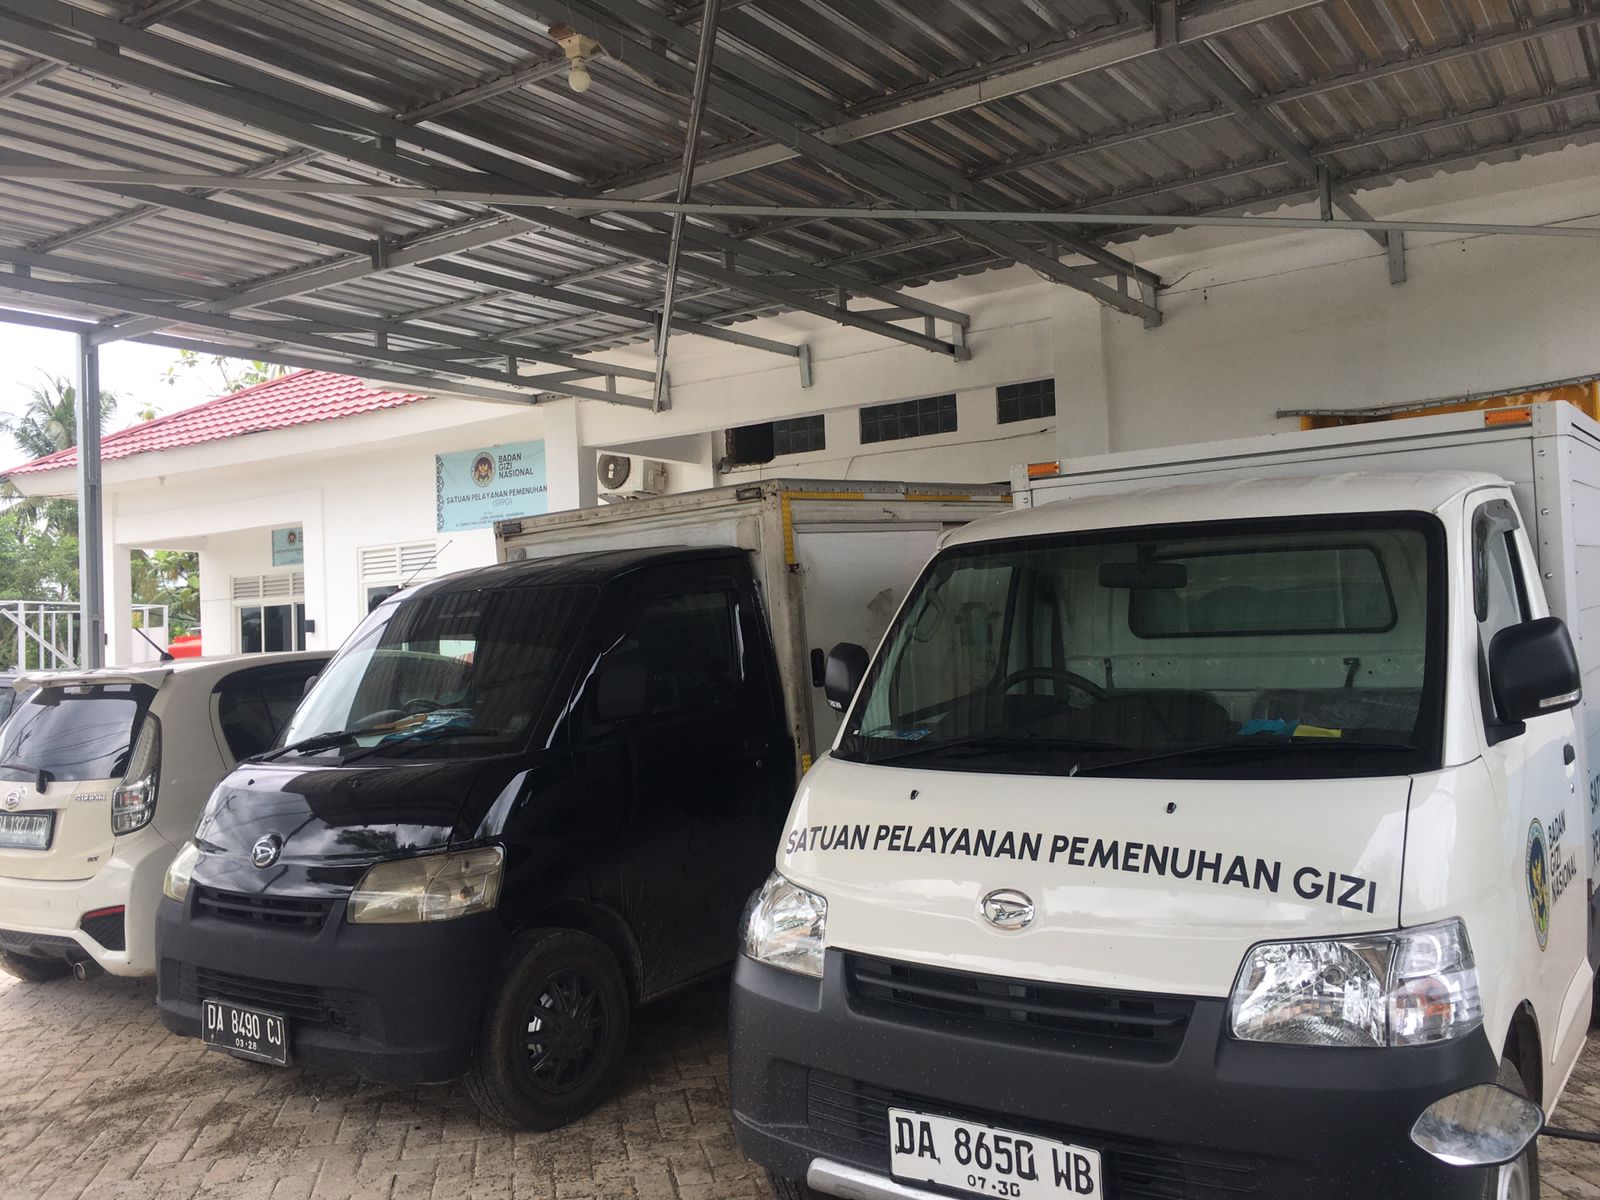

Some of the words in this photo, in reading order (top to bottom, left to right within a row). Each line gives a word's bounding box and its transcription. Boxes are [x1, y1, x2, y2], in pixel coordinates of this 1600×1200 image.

[498, 453, 522, 463] BADAN
[498, 462, 513, 471] GIZI
[498, 467, 534, 480] NASIONAL
[446, 496, 471, 505] SATUAN
[471, 489, 509, 502] PELAYANAN
[508, 485, 548, 497] PEMENUHAN
[1548, 808, 1566, 850] BADAN
[785, 824, 871, 855] SATUAN
[873, 824, 1043, 862] PELAYANAN
[1048, 834, 1282, 893] PEMENUHAN
[1292, 866, 1377, 914] GIZI
[1550, 843, 1562, 876] GIZI
[1551, 851, 1577, 904] NASIONAL
[207, 1004, 224, 1032] DA
[231, 1009, 261, 1040] 8490
[266, 1018, 282, 1046] CJ
[895, 1116, 940, 1162] DA
[953, 1127, 1039, 1181] 8650
[1051, 1147, 1094, 1195] WB
